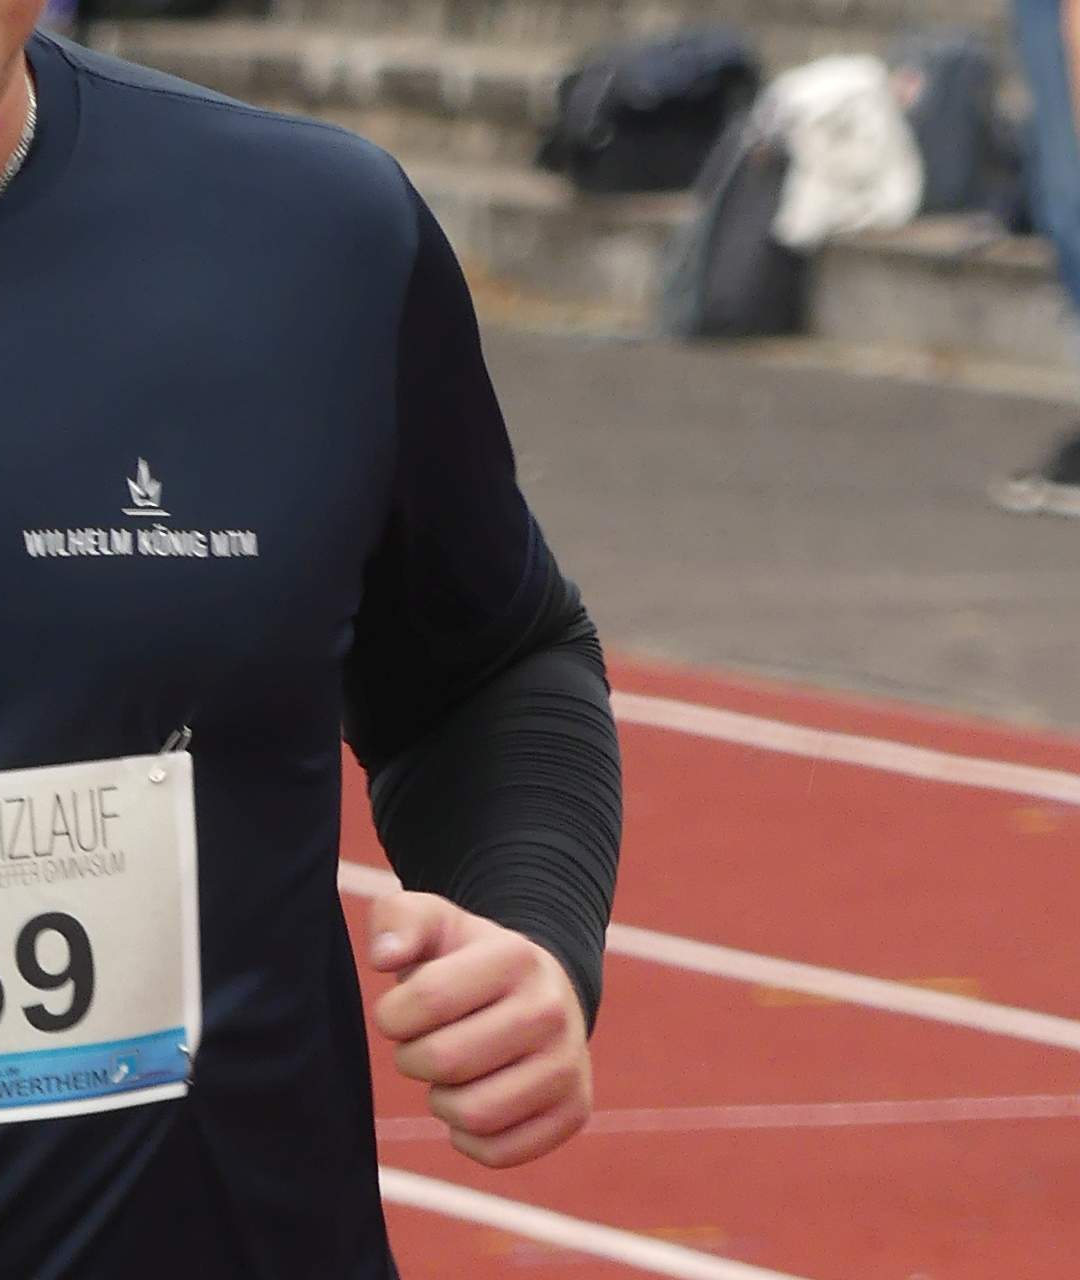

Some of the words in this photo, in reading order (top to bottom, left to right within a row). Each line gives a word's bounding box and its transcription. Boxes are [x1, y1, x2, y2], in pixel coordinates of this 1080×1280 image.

[23, 528, 133, 558] WILHELM
[137, 523, 209, 558] KÖNIG
[210, 530, 259, 558] MTM
